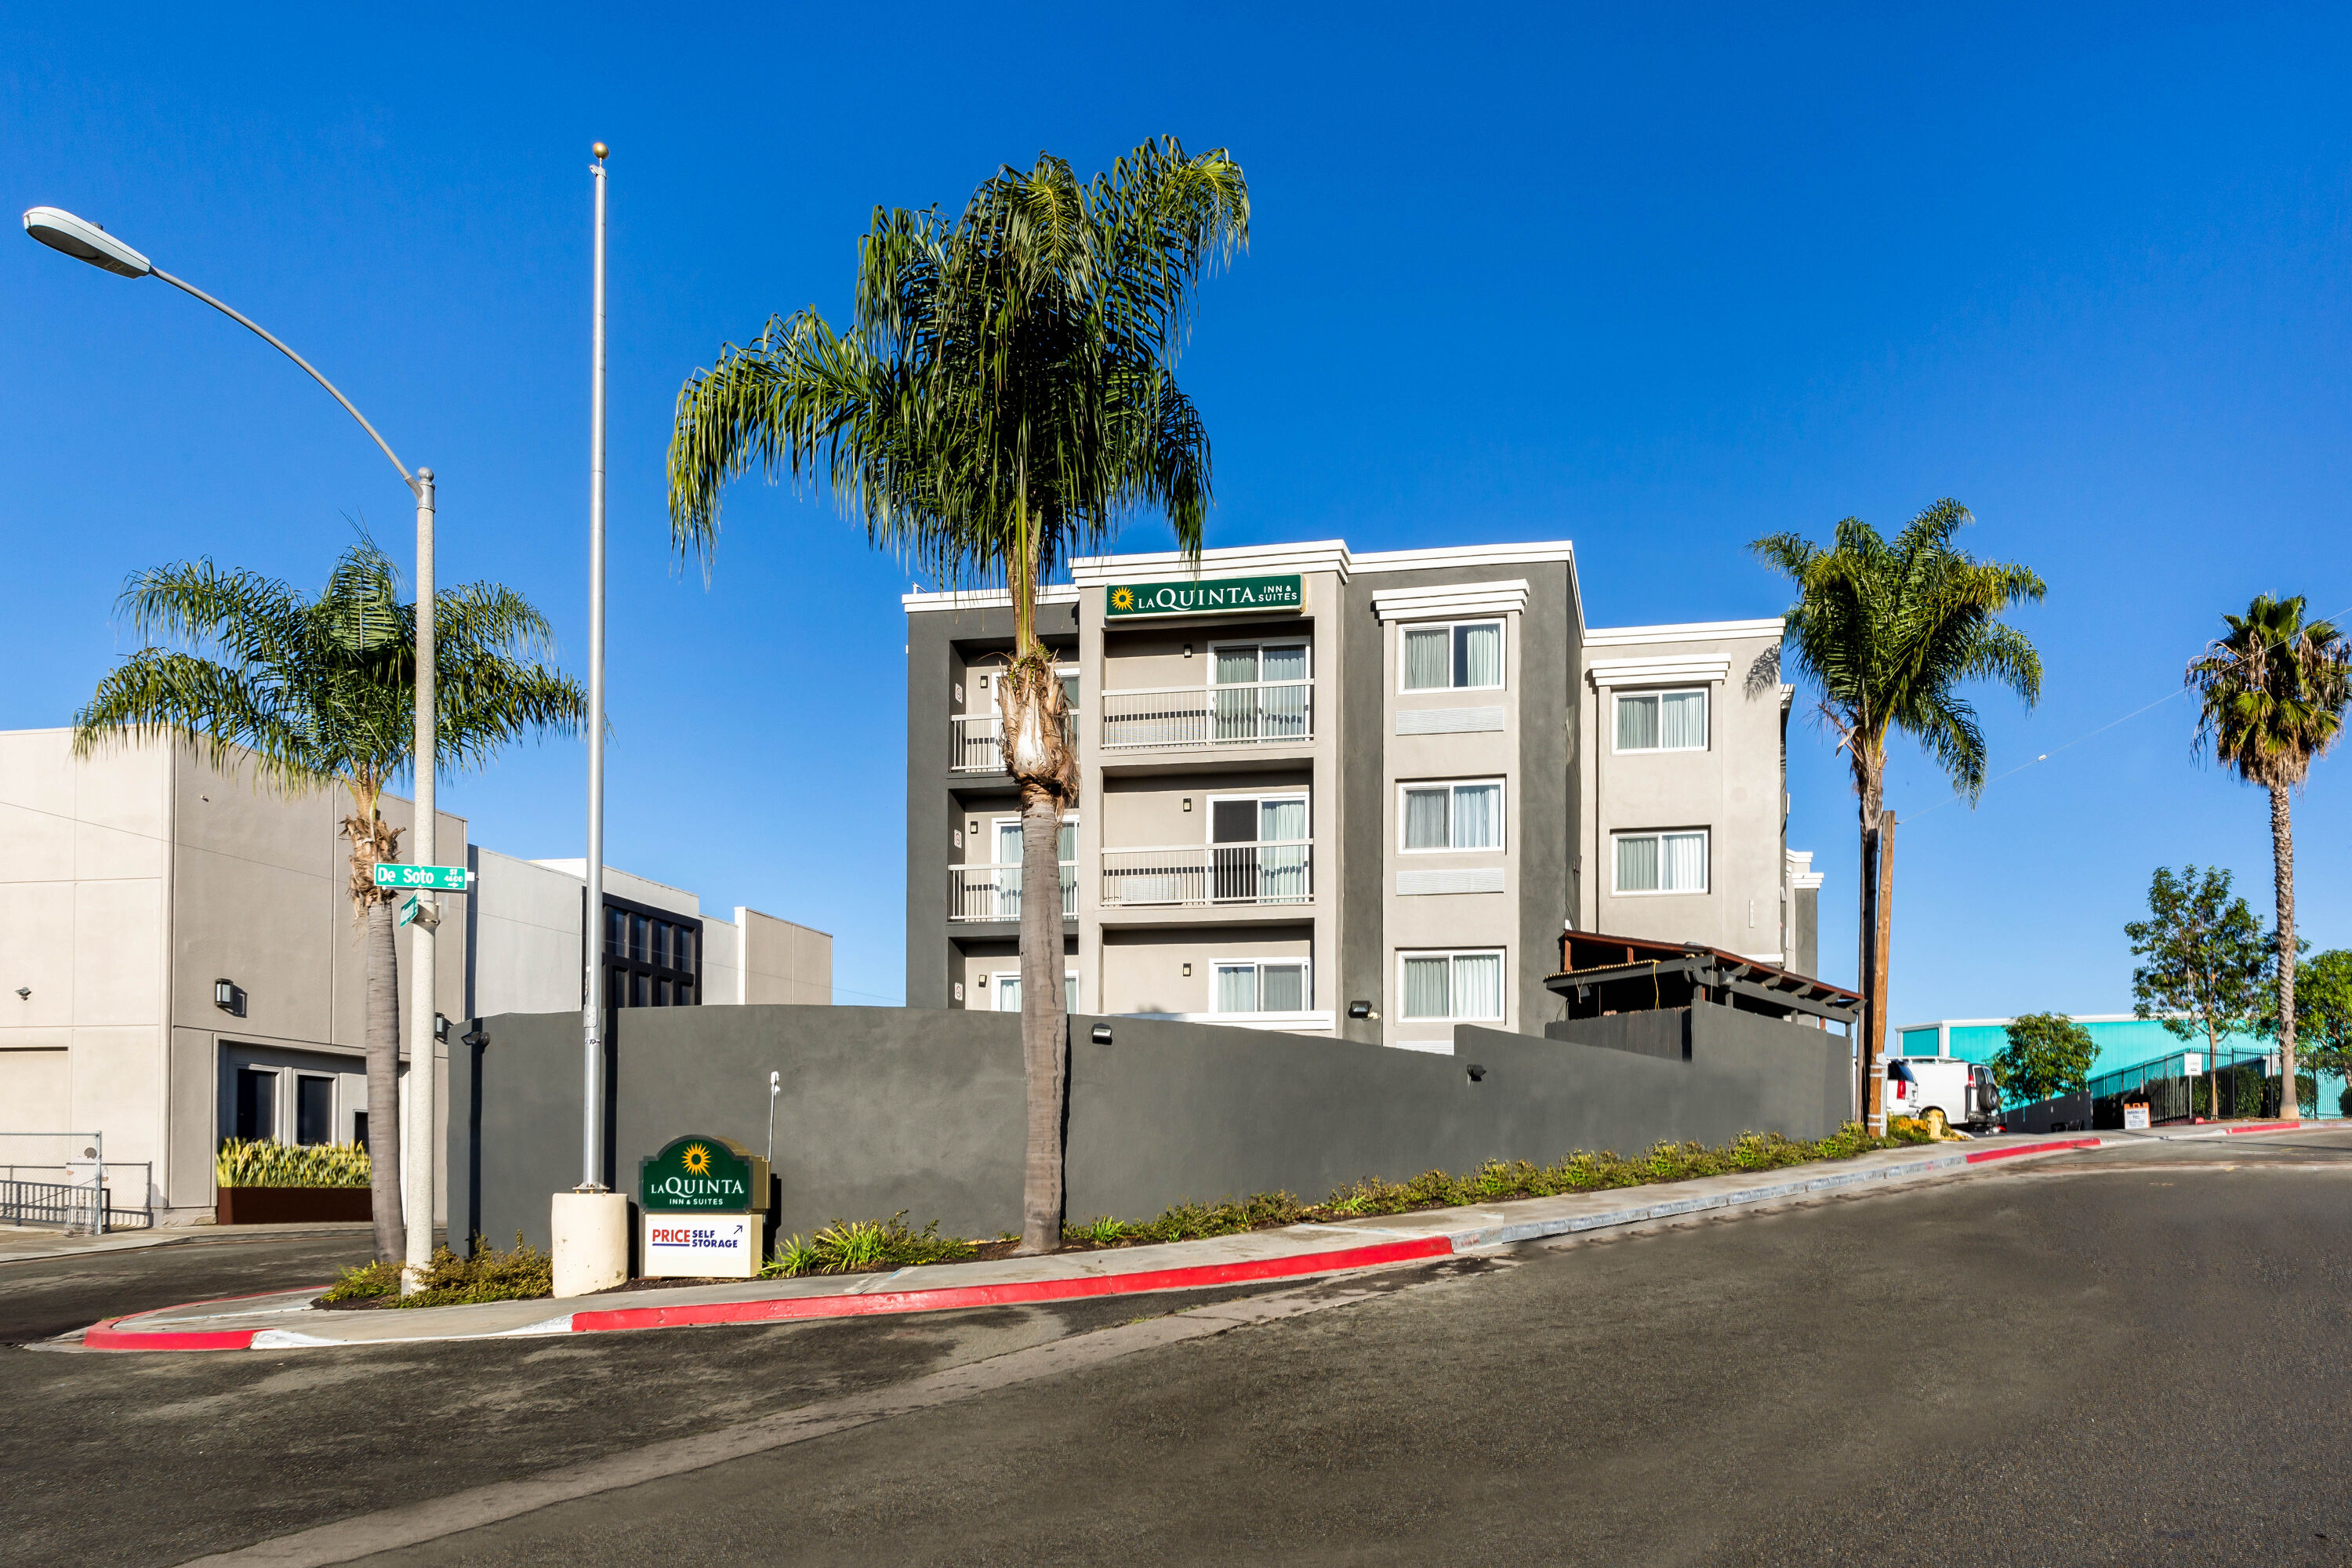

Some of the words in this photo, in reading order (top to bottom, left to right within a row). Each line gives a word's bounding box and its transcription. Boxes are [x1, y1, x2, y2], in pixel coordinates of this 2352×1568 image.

[1138, 598, 1156, 608] LA
[1156, 587, 1256, 611] QUINTA
[1258, 593, 1298, 601] SUITES
[378, 867, 396, 882] De
[403, 868, 434, 884] Soto
[652, 1185, 665, 1193] LA
[665, 1177, 745, 1198] QUINTA
[652, 1229, 691, 1243] PRICE
[691, 1240, 738, 1248] STORAGE
